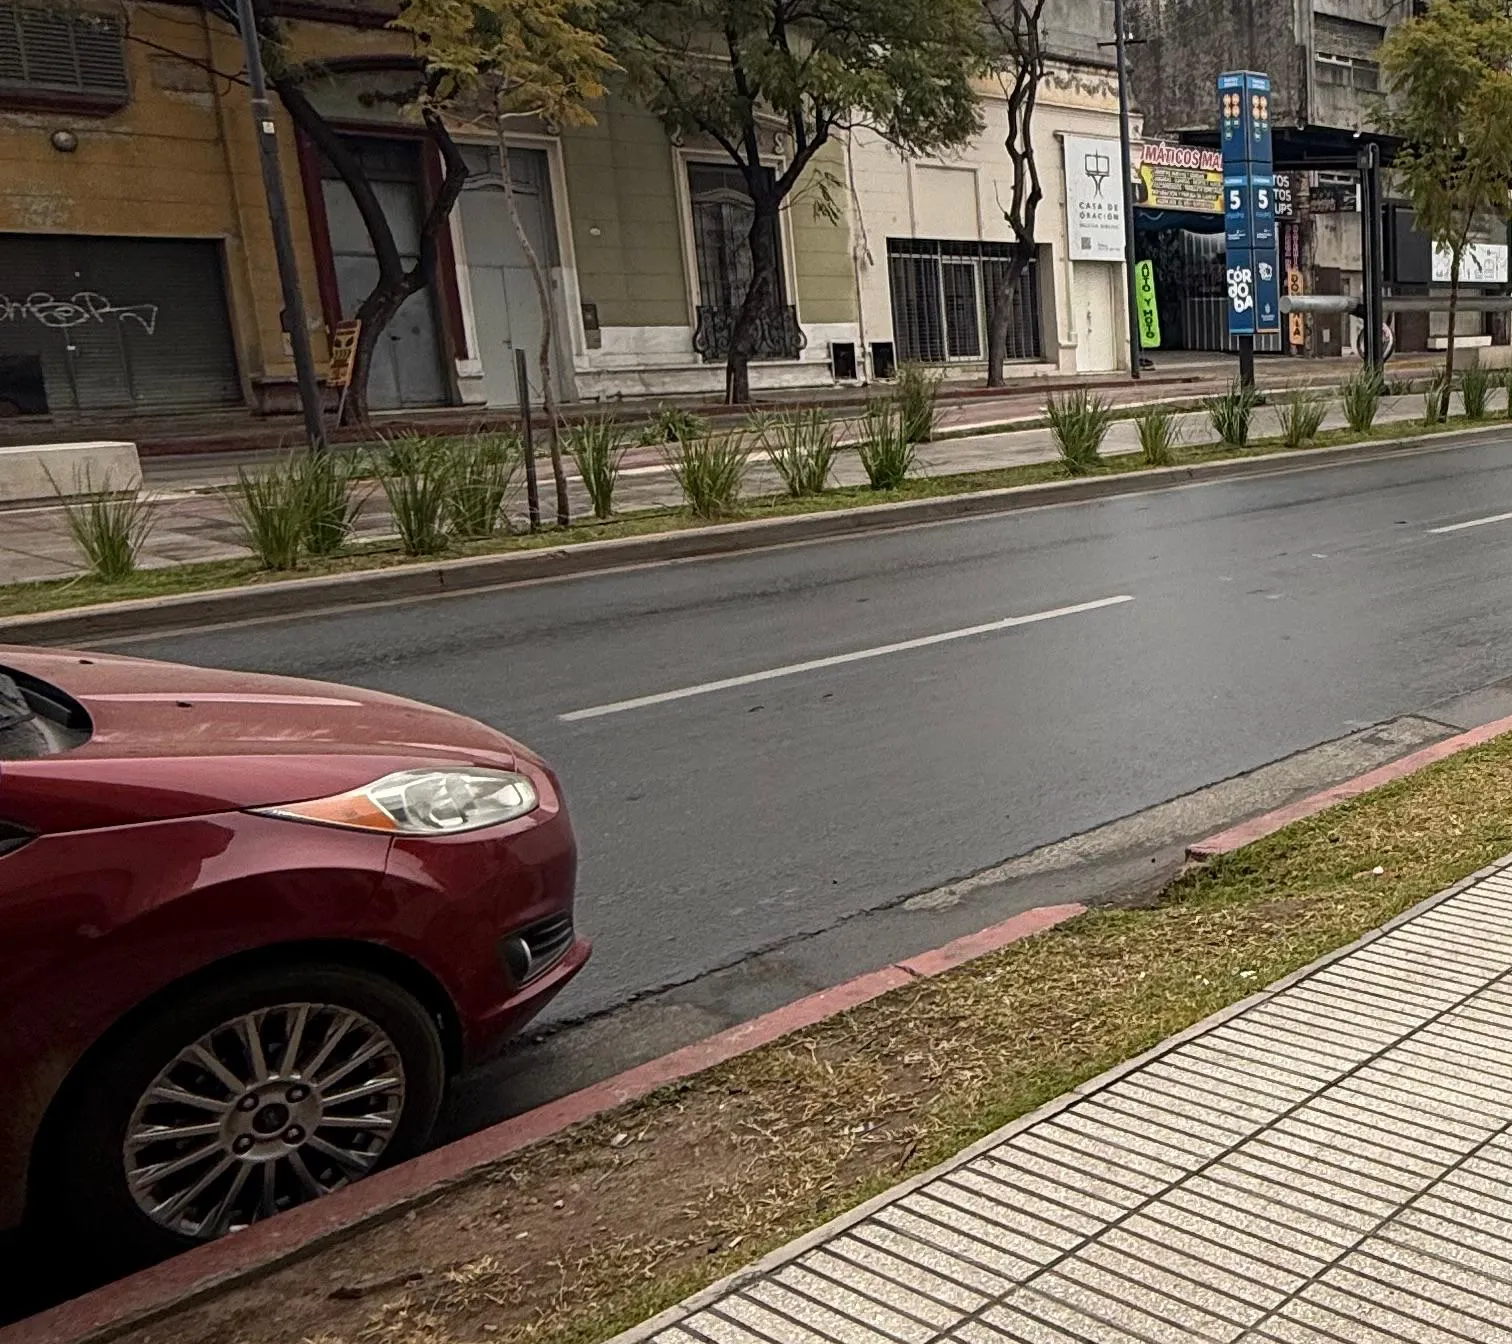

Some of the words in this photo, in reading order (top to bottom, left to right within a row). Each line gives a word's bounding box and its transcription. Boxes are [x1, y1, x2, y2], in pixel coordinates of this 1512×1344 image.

[1079, 201, 1103, 210] CASA
[1107, 203, 1118, 212] DE
[1230, 189, 1241, 210] 5
[1258, 189, 1269, 209] 5
[1141, 263, 1151, 292] AUTO
[1143, 298, 1152, 306] Y
[1143, 309, 1155, 339] MOTO
